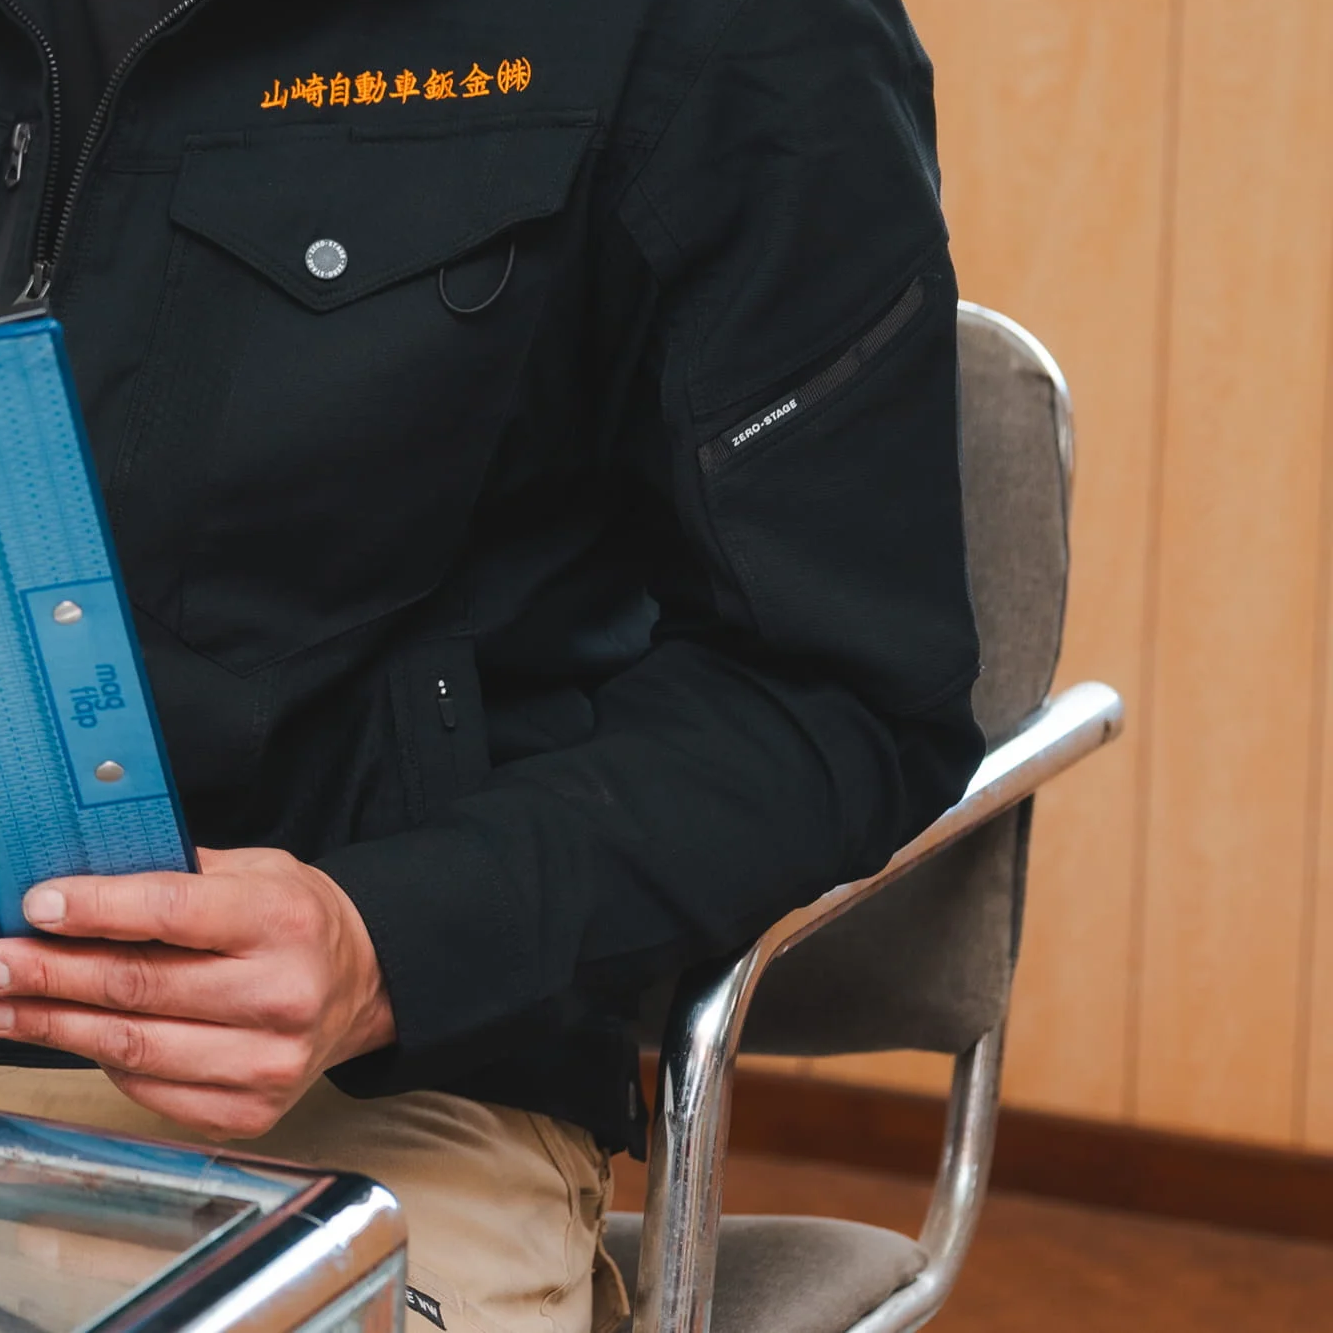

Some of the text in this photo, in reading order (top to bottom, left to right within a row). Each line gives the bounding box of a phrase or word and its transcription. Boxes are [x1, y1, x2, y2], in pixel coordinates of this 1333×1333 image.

[731, 398, 798, 447] ZERO-STAGE
[69, 686, 98, 729] flap
[95, 663, 126, 712] mag
